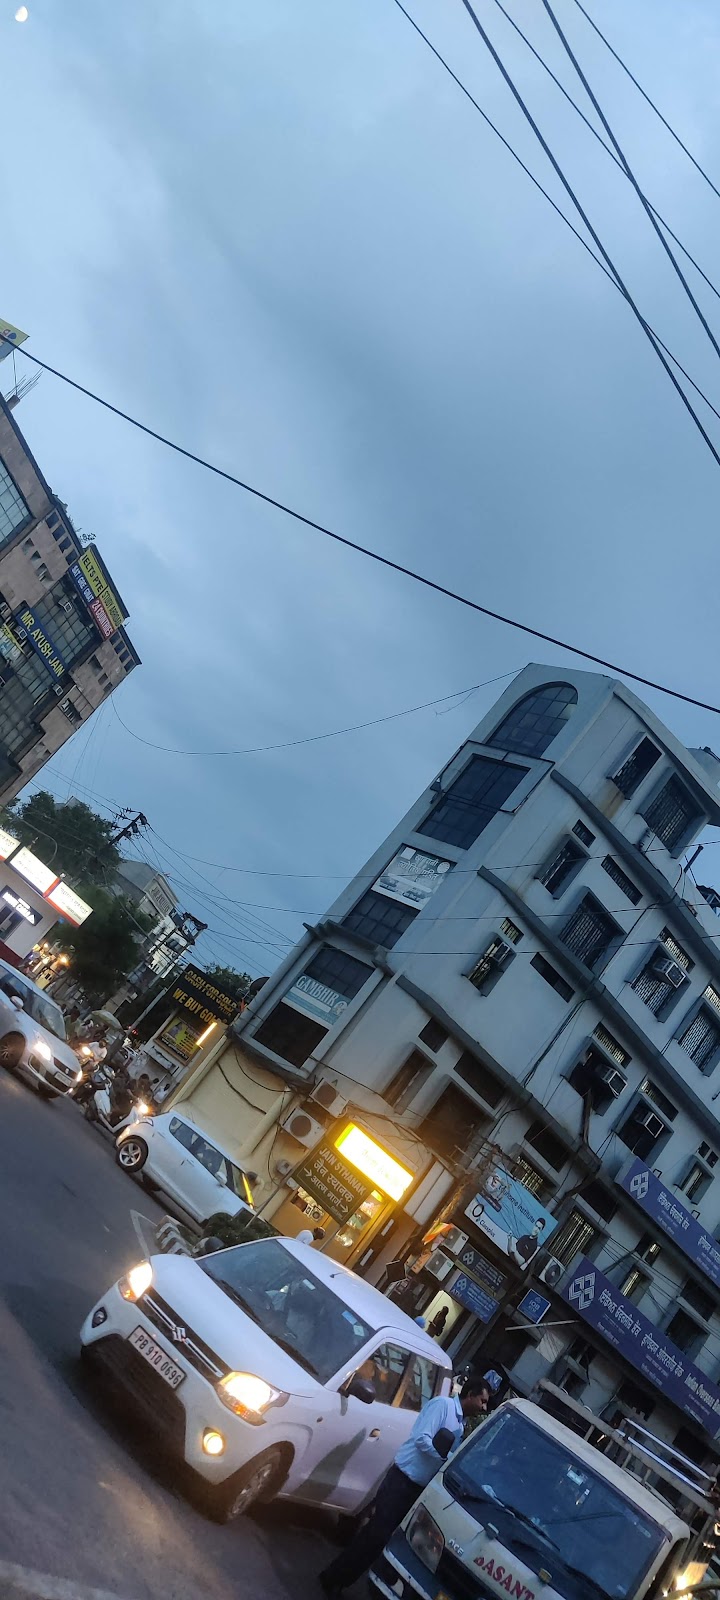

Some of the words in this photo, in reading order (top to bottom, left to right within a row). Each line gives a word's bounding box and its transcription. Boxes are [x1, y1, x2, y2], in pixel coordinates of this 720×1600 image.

[81, 554, 96, 578] IELTS
[92, 576, 103, 593] PTE
[90, 599, 101, 612] 24
[94, 608, 113, 637] COUNTRIES
[19, 609, 37, 632] MR.
[29, 627, 54, 659] AYUSH
[47, 655, 65, 677] JAIN
[171, 987, 188, 1004] WE
[183, 995, 203, 1015] BUY
[182, 968, 206, 991] CASH
[201, 983, 220, 1000] FOR
[214, 992, 238, 1013] GOLD
[294, 973, 339, 1007] GAMBHIR
[311, 1156, 330, 1177] जैन
[324, 1172, 355, 1203] स्थानक
[318, 1145, 338, 1166] JAIN
[333, 1161, 367, 1195] STHANAK
[478, 1218, 496, 1238] Classplus
[134, 1333, 149, 1350] PB
[158, 1360, 182, 1385] 0696
[683, 1372, 699, 1392] Indian
